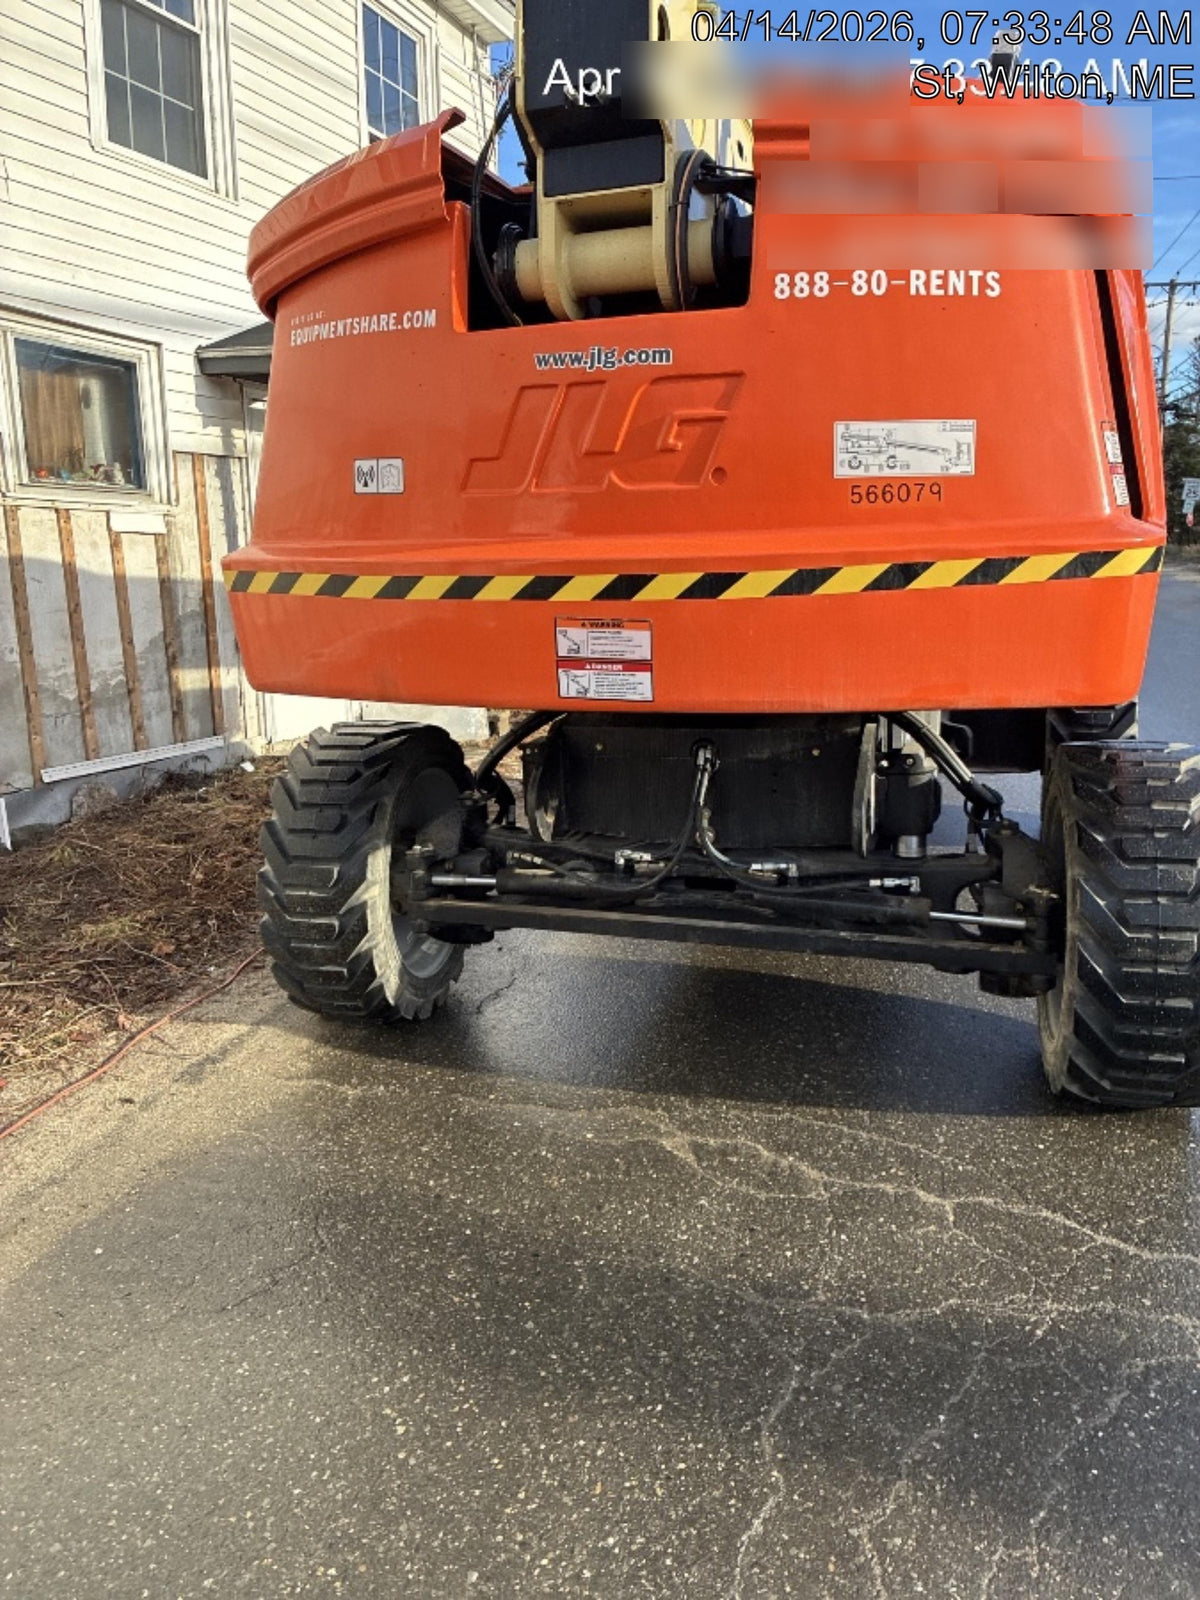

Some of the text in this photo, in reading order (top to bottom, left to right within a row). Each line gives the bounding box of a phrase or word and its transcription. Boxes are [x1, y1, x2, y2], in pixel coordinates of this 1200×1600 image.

[773, 269, 1002, 300] 888-80-RENTS
[290, 308, 437, 347] EQUIPMENTSHARE.COM
[534, 346, 673, 370] www.jlg.com
[850, 482, 942, 504] 566079
